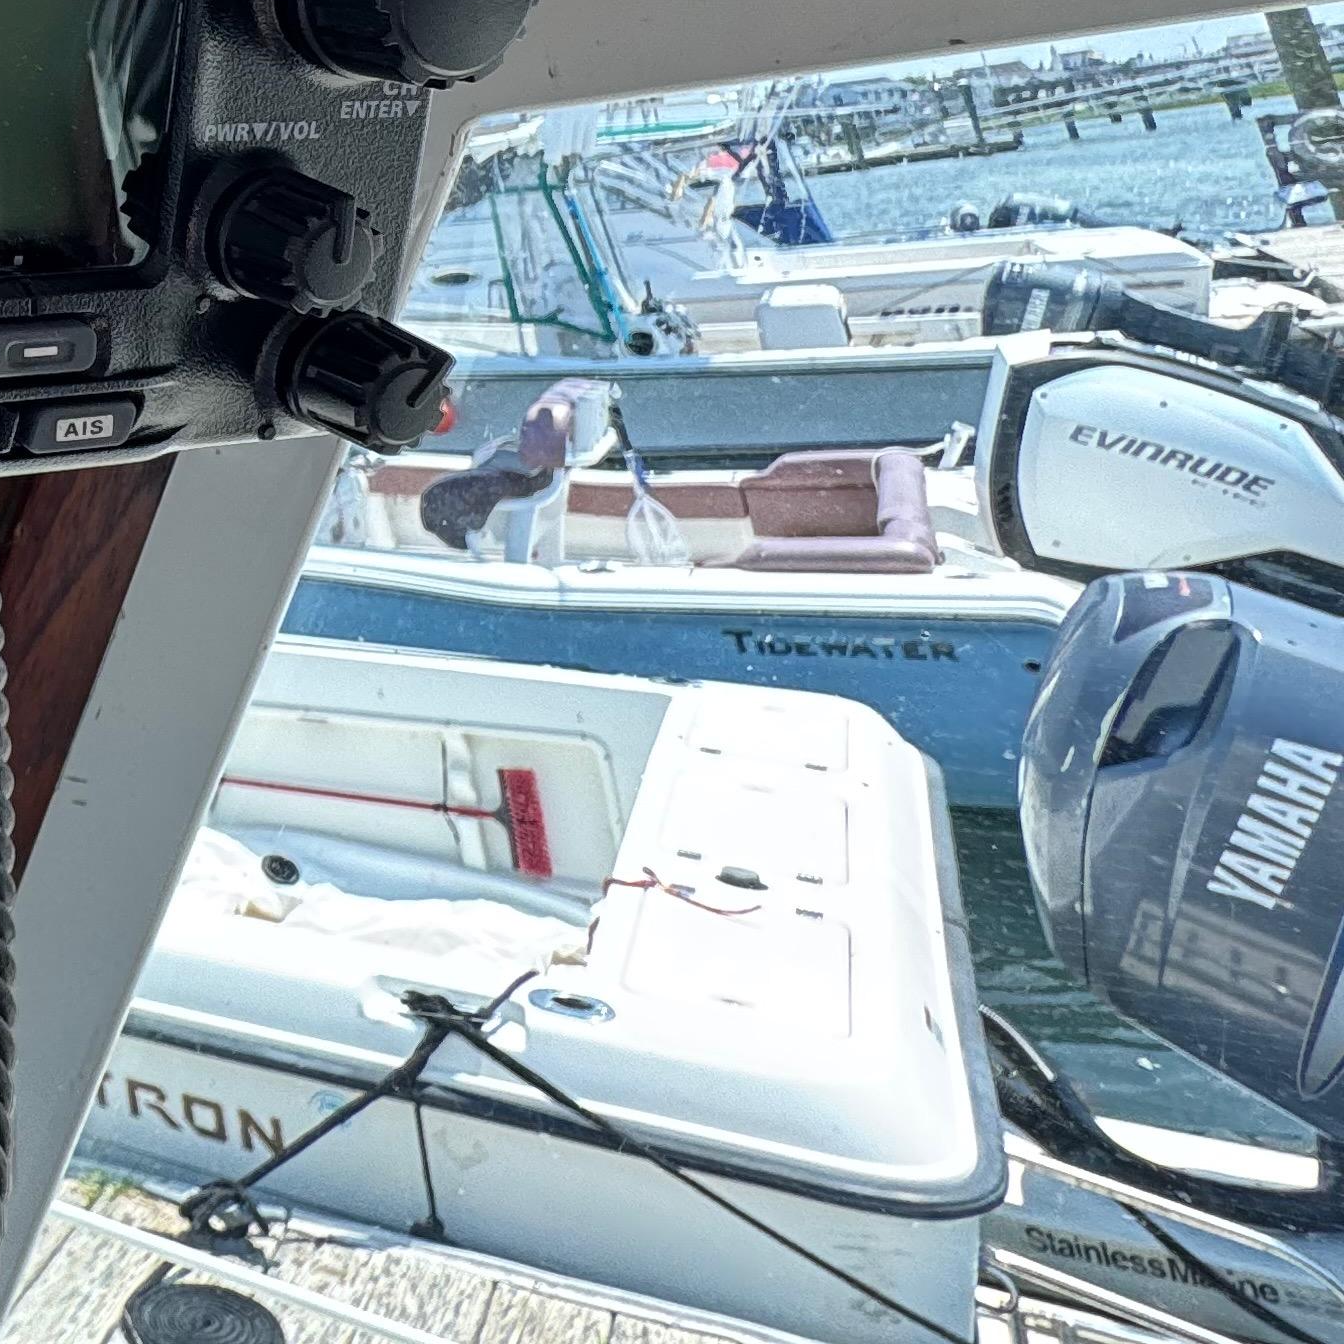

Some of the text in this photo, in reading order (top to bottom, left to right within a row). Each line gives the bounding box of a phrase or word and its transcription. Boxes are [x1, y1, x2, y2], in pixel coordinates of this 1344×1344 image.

[340, 100, 403, 119] ENTER
[63, 419, 105, 439] AIS
[1068, 423, 1277, 498] EVINRUDE
[1206, 737, 1344, 911] YAMAHA
